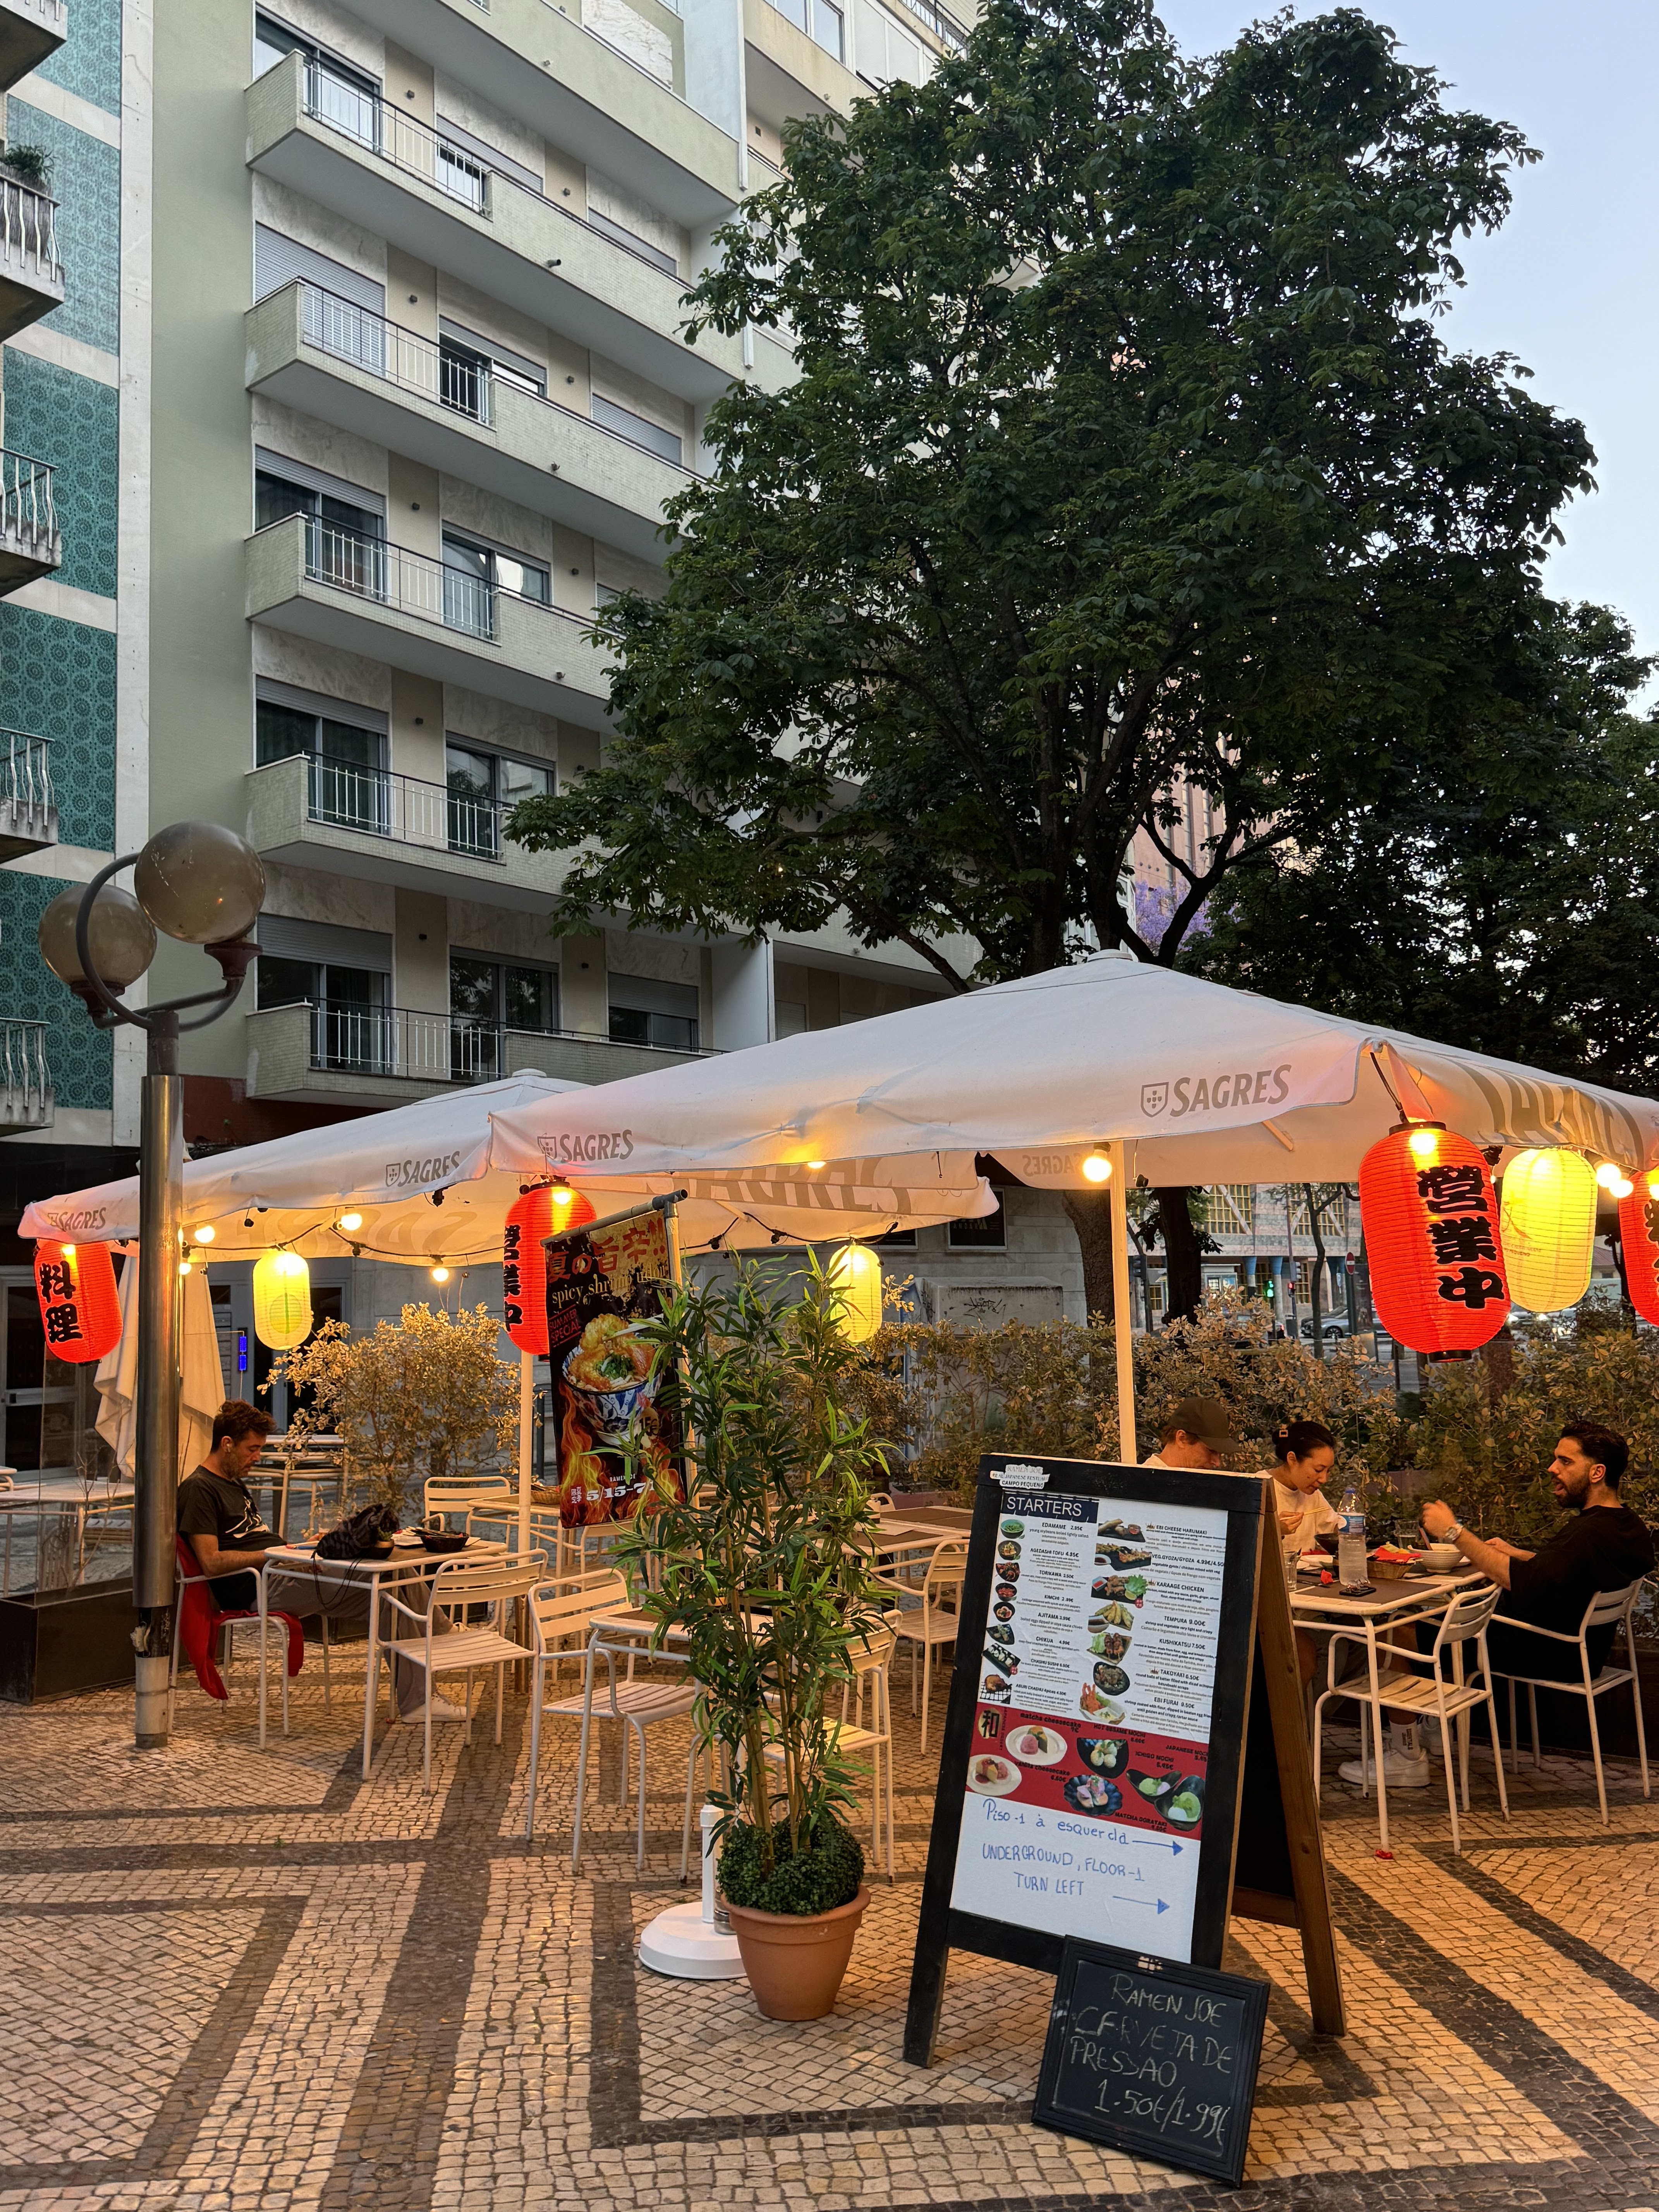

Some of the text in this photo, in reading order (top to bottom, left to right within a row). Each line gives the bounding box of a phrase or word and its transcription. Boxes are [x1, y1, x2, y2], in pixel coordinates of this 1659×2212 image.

[1170, 1064, 1292, 1118] SAGRES
[560, 1129, 634, 1162] SAGRES
[399, 1151, 460, 1188] SAGRES
[58, 1207, 106, 1231] SAGRES
[1416, 1165, 1505, 1309] 営業中
[39, 1260, 82, 1343] 料理
[552, 1284, 584, 1309] spicy
[588, 1274, 632, 1296] shrimp
[548, 1309, 577, 1331] SUMMER
[551, 1319, 581, 1344] SPECIAL
[1007, 1496, 1082, 1517] STARTERS
[1159, 1638, 1191, 1647] KUSHIKATSU
[981, 1710, 1000, 1738] 和
[982, 1798, 1011, 1822] Piso
[1057, 1820, 1129, 1845] esquerda
[1014, 1872, 1084, 1896] TURN LEFT
[1109, 1973, 1227, 2028] RAMEN JOE
[1202, 2037, 1234, 2074] DE
